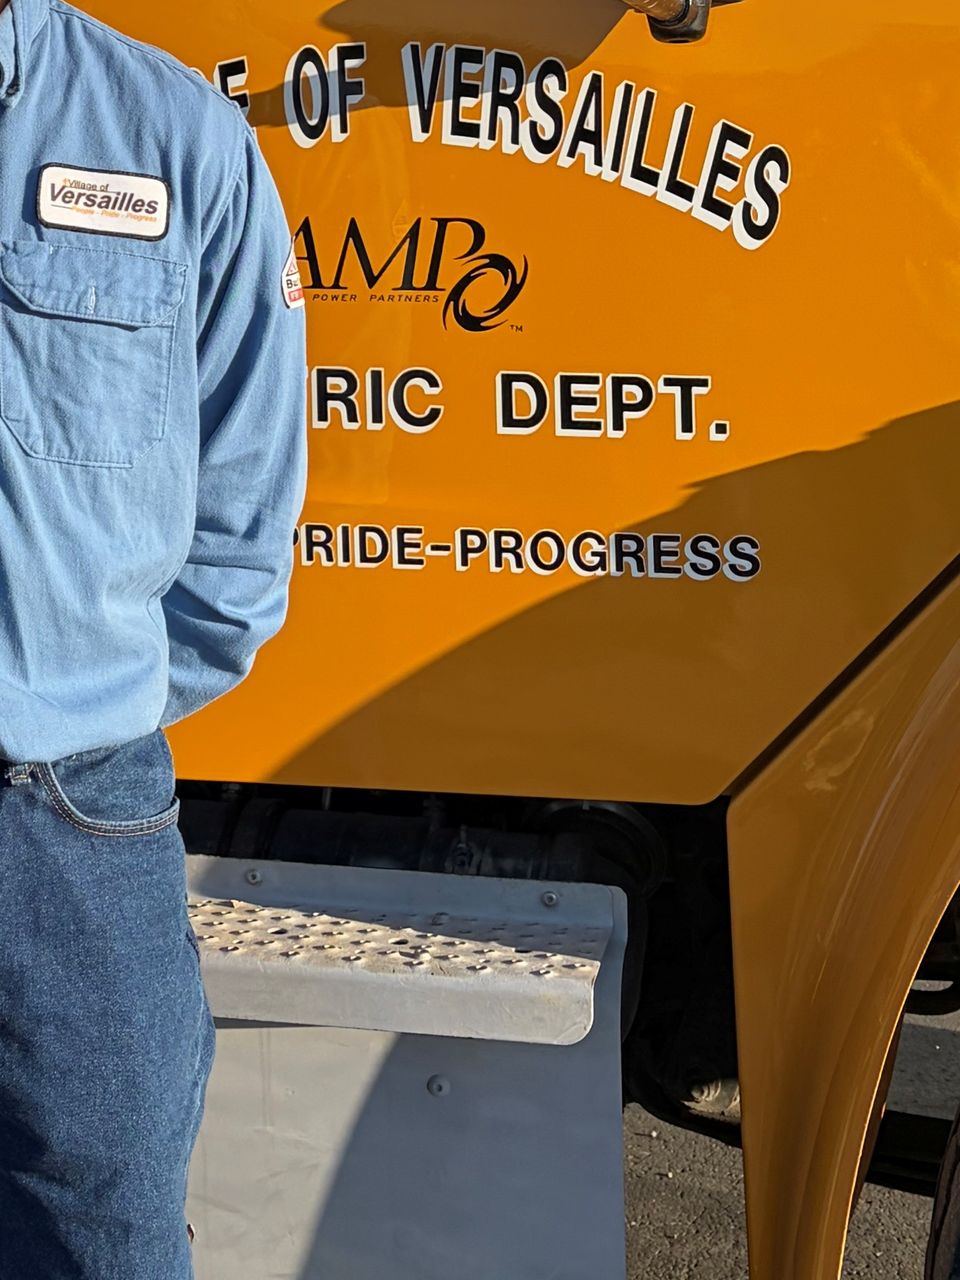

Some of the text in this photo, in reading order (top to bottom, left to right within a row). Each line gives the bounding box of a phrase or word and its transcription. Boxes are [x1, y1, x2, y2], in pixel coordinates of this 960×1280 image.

[284, 42, 366, 148] OF
[401, 41, 791, 250] VERSAILLES
[50, 183, 159, 215] Versailles
[67, 179, 110, 191] Village of
[293, 216, 486, 290] AMP
[312, 293, 358, 302] POWER
[369, 294, 440, 303] PARTNERS
[309, 366, 730, 441] RIC DEPT.
[293, 523, 761, 582] RIDE-PROGRESS
